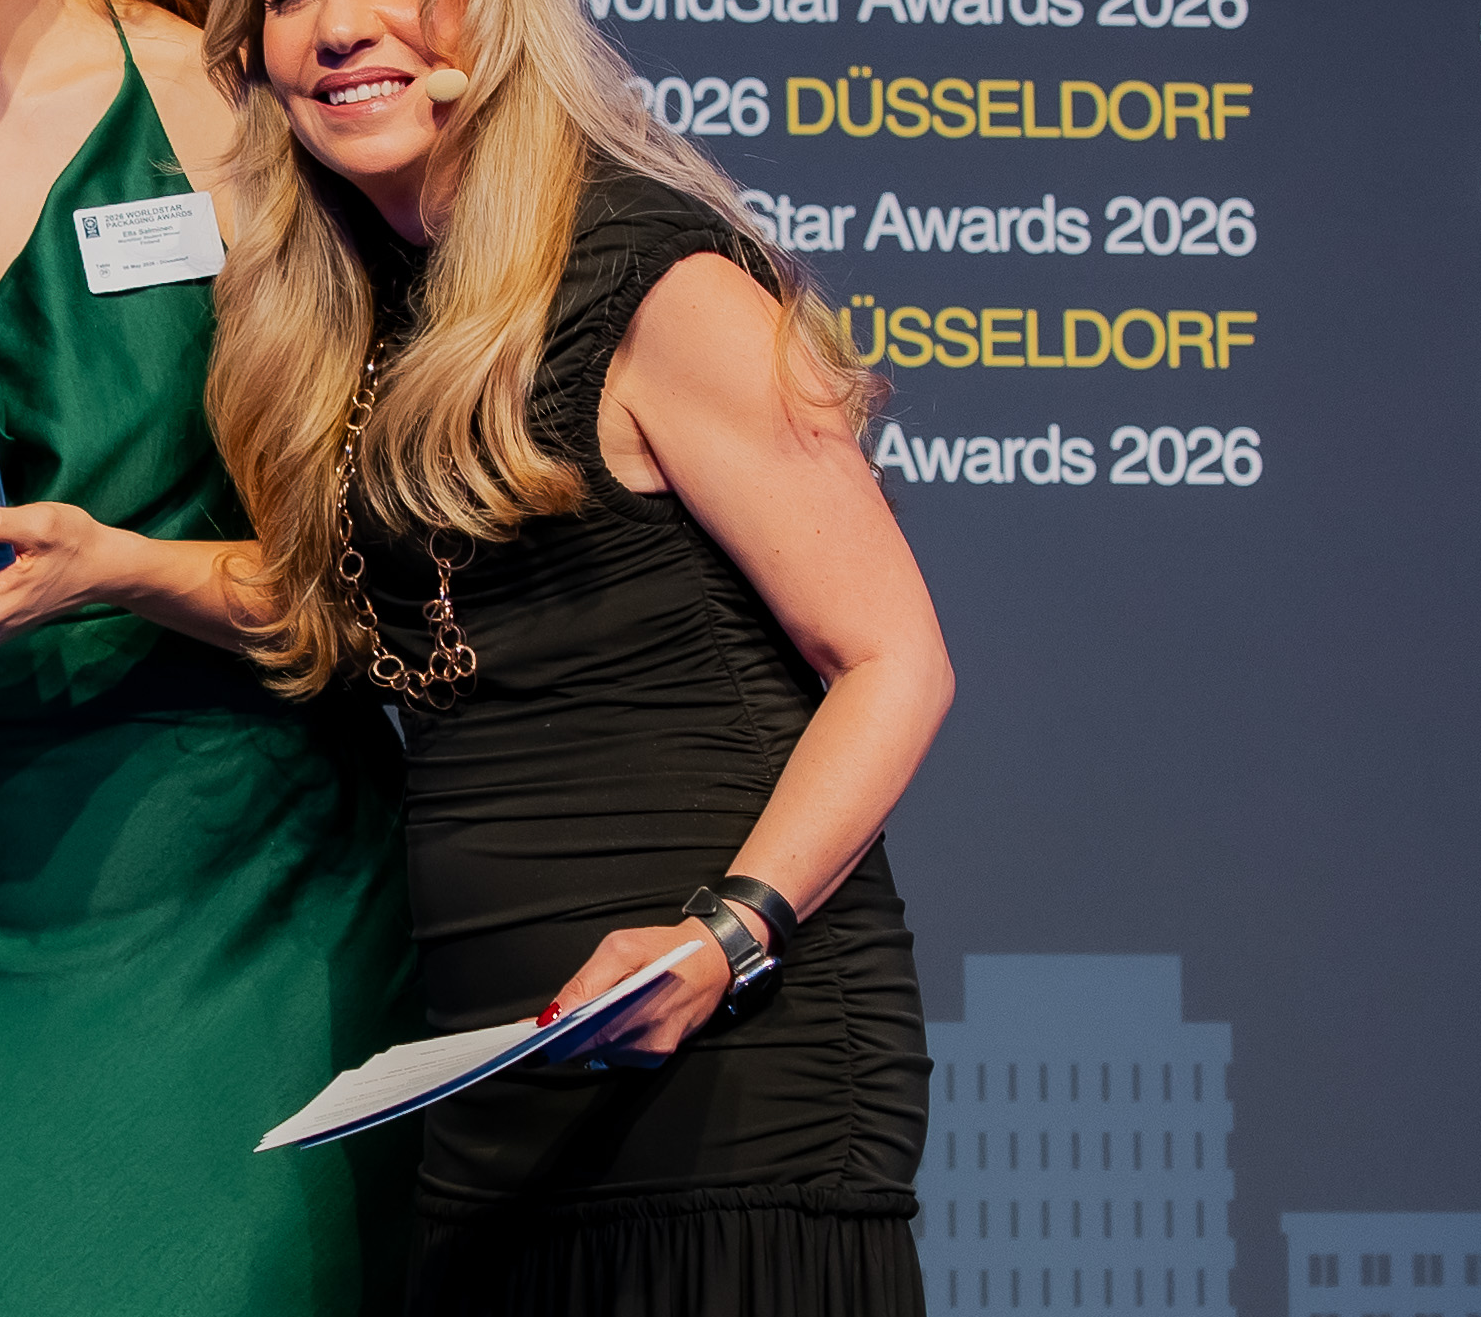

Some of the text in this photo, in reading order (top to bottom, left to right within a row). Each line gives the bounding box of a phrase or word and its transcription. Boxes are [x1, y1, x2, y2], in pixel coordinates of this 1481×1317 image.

[787, 66, 1253, 140] DÜSSELDORF
[106, 217, 155, 229] PACKAGING
[157, 210, 193, 221] AWARDS
[126, 204, 182, 219] WORLDSTAR
[864, 192, 1091, 254] Awards
[1105, 196, 1256, 256] 2026
[840, 294, 1257, 370] ÜSSELDORF
[875, 422, 1262, 486] Awards 2026
